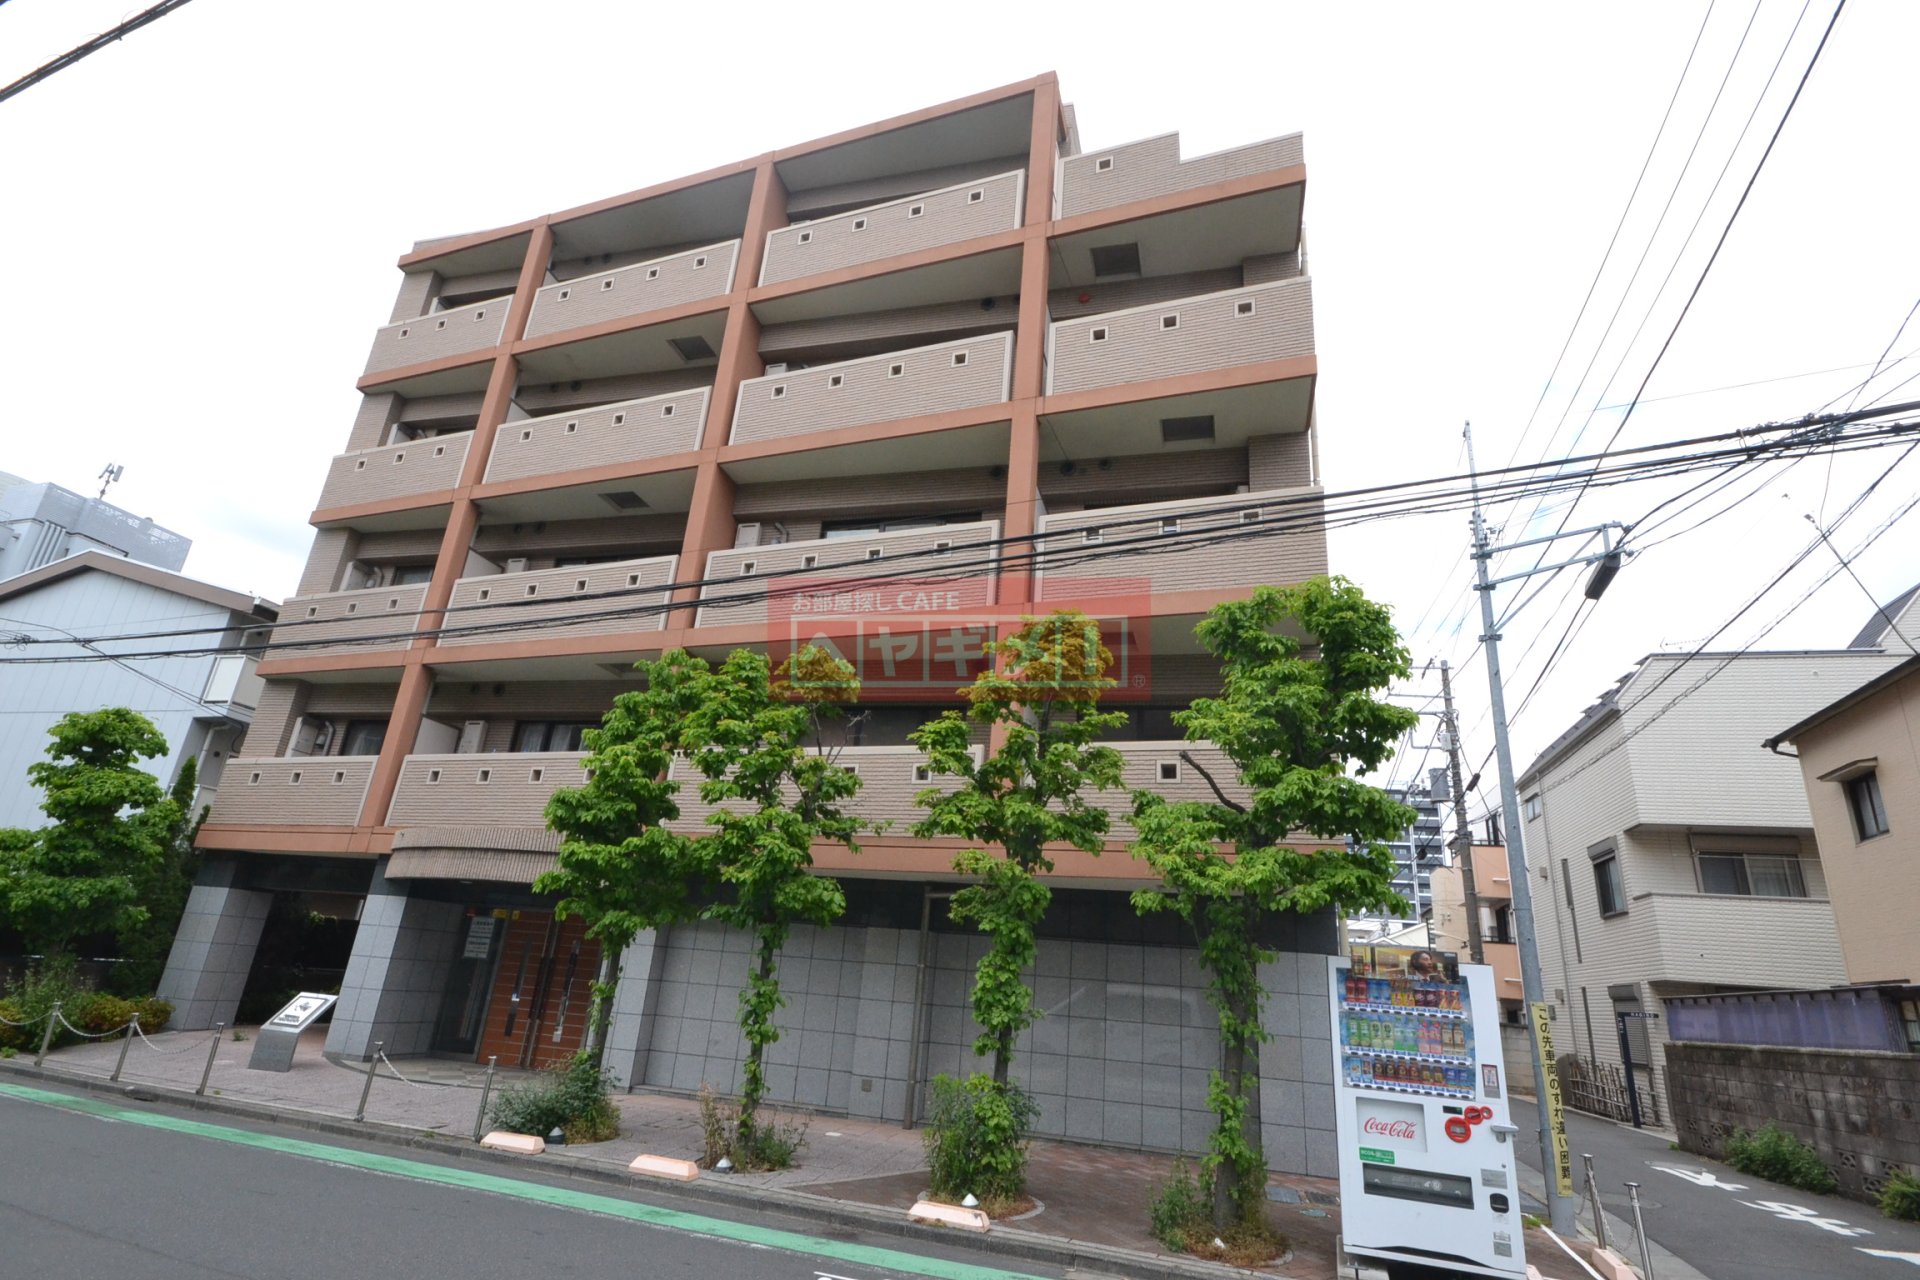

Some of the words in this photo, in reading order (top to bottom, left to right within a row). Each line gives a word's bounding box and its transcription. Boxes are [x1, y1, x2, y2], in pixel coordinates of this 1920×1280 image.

[1364, 1116, 1417, 1139] Coca-Cola
[1539, 1008, 1570, 1180] この先車両のすれ違い困難
